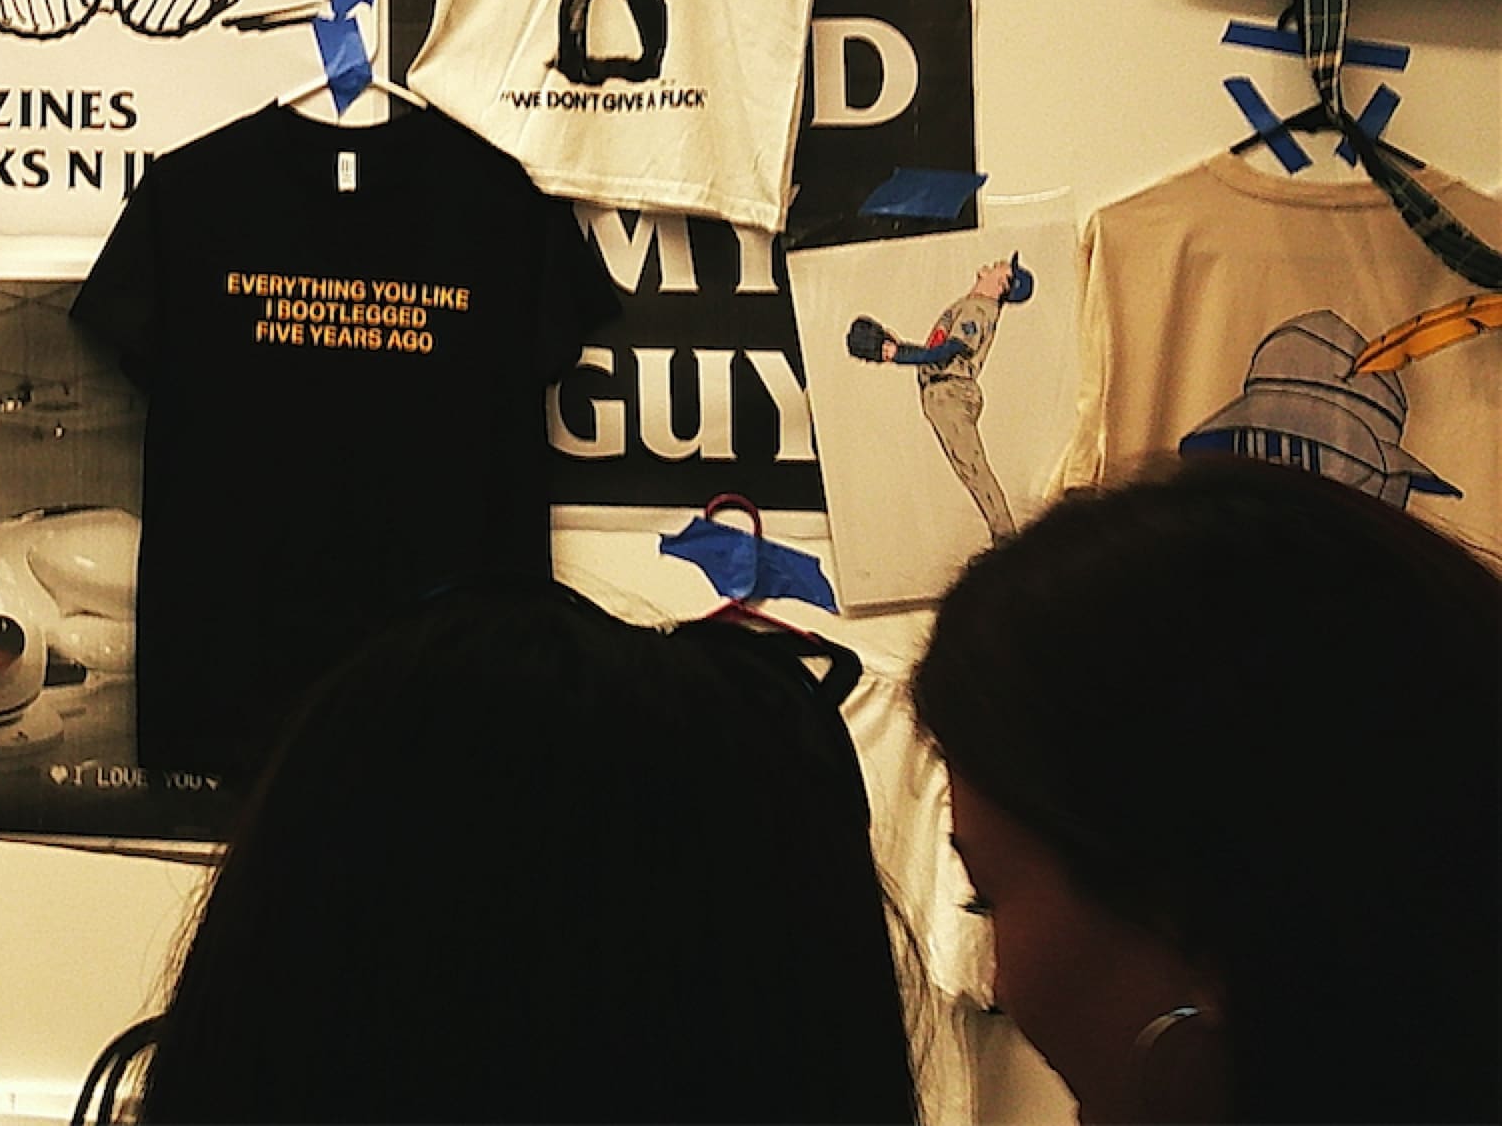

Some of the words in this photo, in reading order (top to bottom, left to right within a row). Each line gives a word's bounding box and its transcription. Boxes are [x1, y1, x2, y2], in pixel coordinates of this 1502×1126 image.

[602, 92, 643, 112] GIVE
[648, 92, 657, 108] A
[68, 149, 103, 190] N
[227, 272, 366, 301] EVERYTHING
[372, 281, 416, 304] YOU
[422, 284, 470, 311] LIKE
[265, 298, 273, 320] I
[277, 299, 427, 329] BOOTLEGGED
[256, 321, 304, 345] FIVE
[310, 325, 382, 350] YEARS
[387, 329, 433, 354] AGO
[546, 346, 817, 462] GUY
[97, 767, 147, 787] LOVE
[163, 772, 203, 790] YOU
